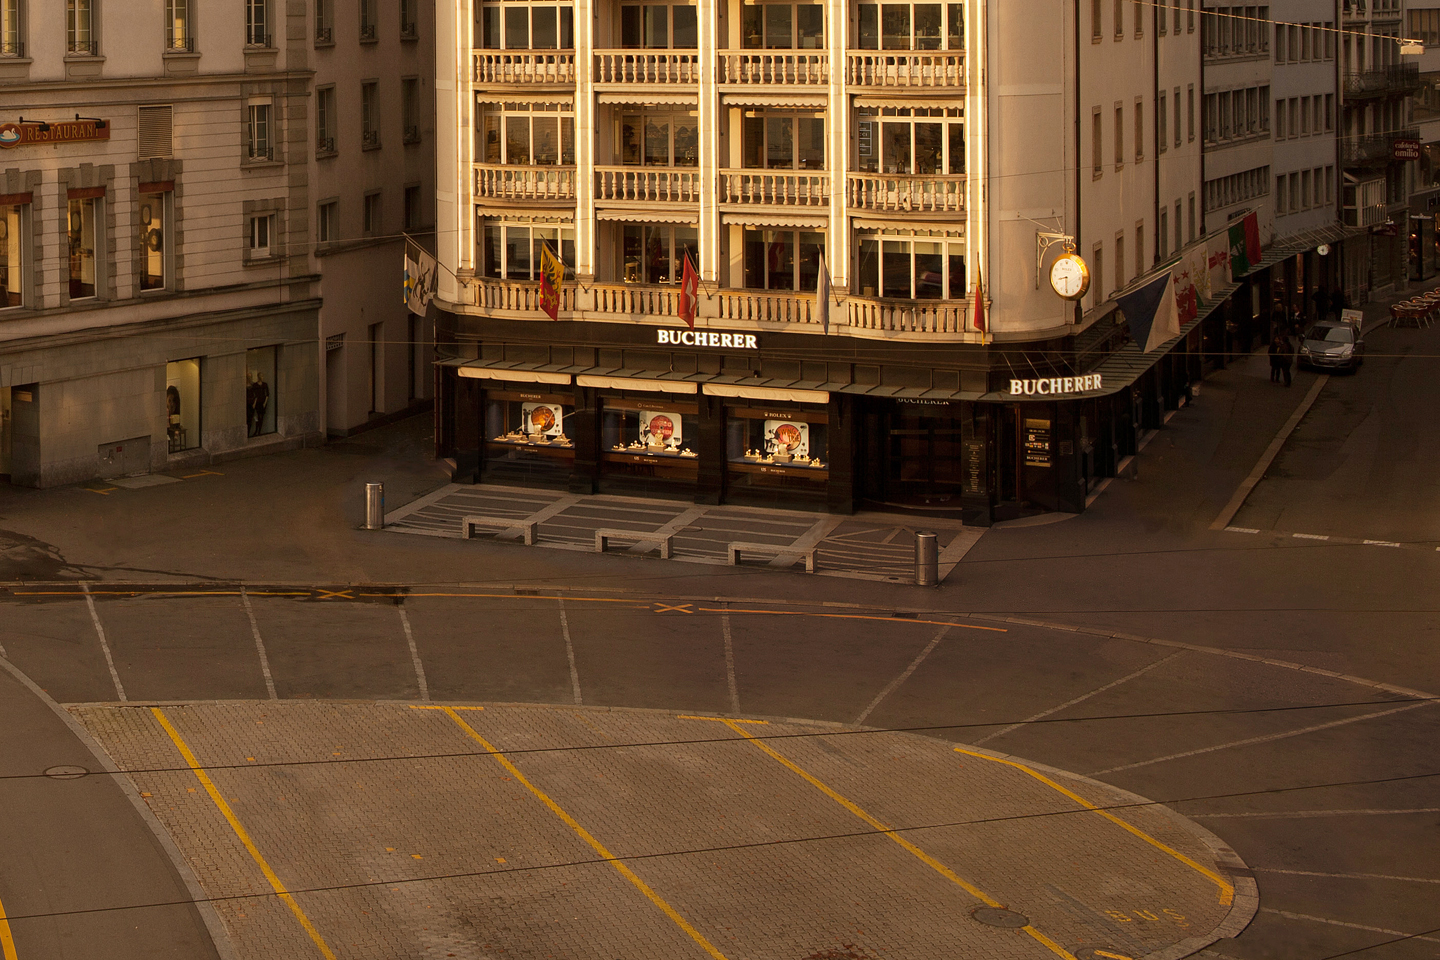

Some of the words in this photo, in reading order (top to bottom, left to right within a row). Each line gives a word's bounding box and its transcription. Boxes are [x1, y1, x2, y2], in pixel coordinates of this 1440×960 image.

[1394, 148, 1419, 158] emilio
[657, 329, 758, 349] BUCHERER
[1009, 374, 1102, 395] BUCHERER
